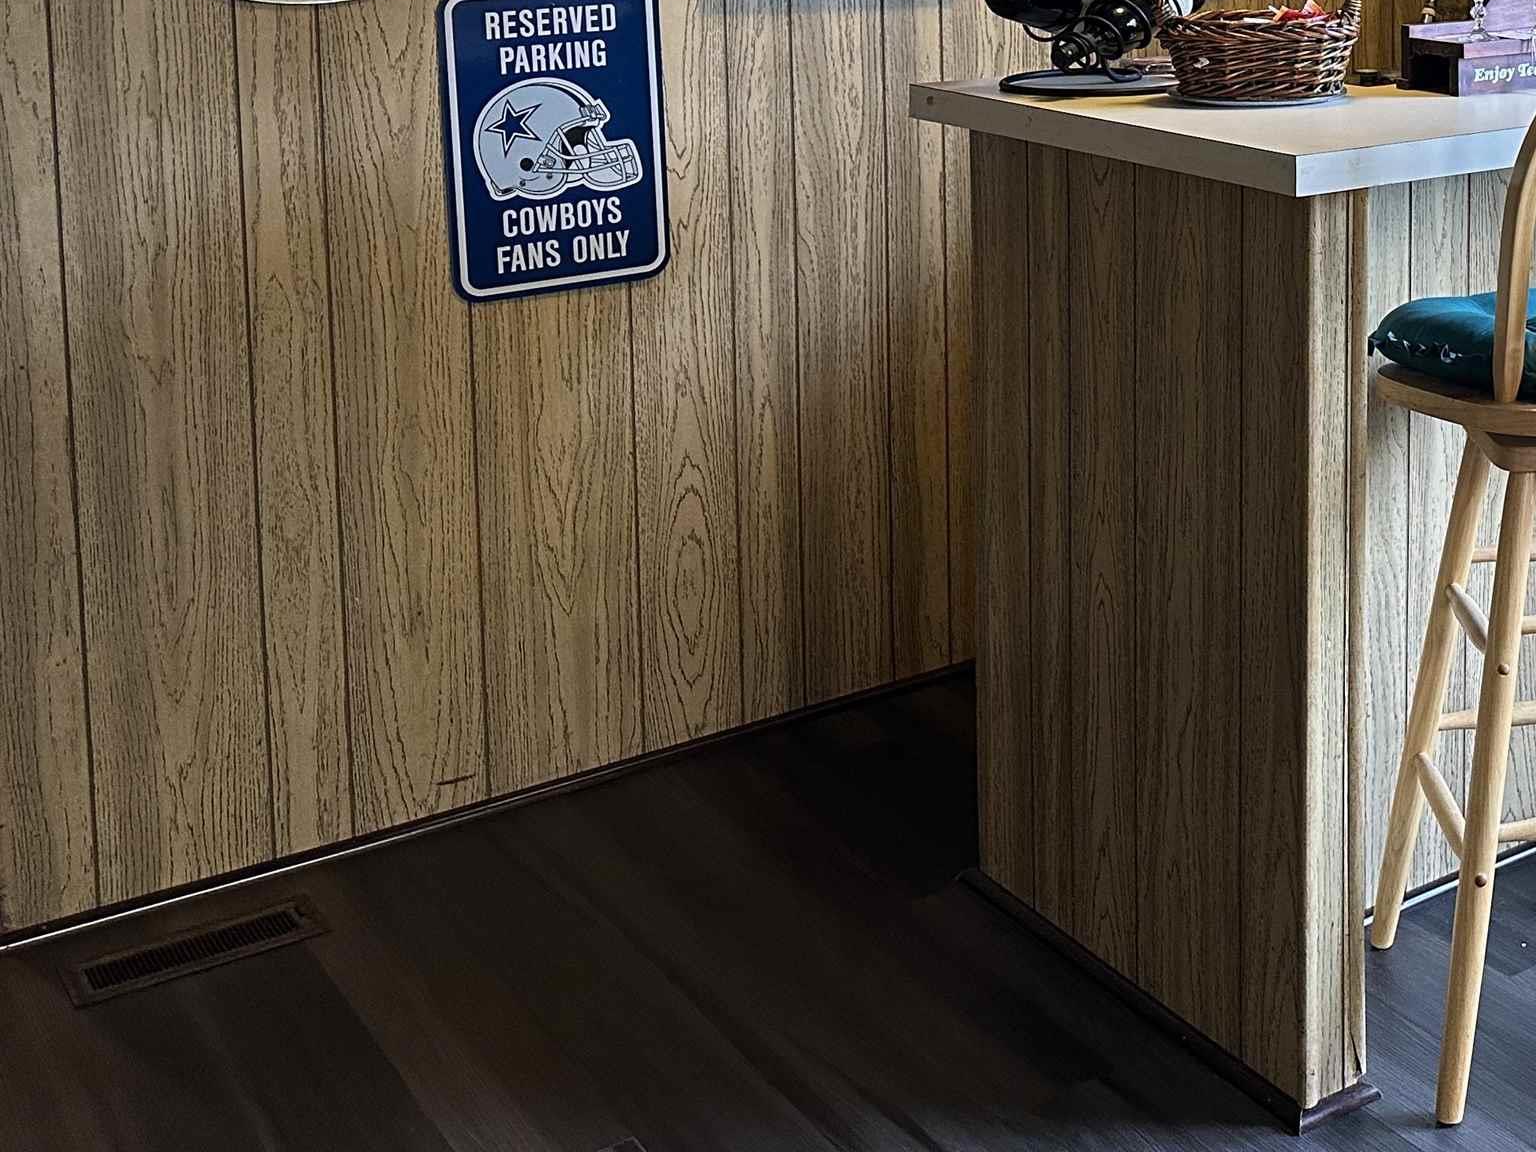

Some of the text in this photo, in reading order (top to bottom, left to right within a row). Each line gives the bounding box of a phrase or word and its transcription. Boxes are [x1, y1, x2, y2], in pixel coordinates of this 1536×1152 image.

[485, 3, 617, 41] RESERVED
[500, 39, 607, 75] PARKING
[1474, 65, 1516, 84] Enjoy
[502, 197, 623, 238] COWBOYS
[497, 230, 631, 275] FANS ONLY
